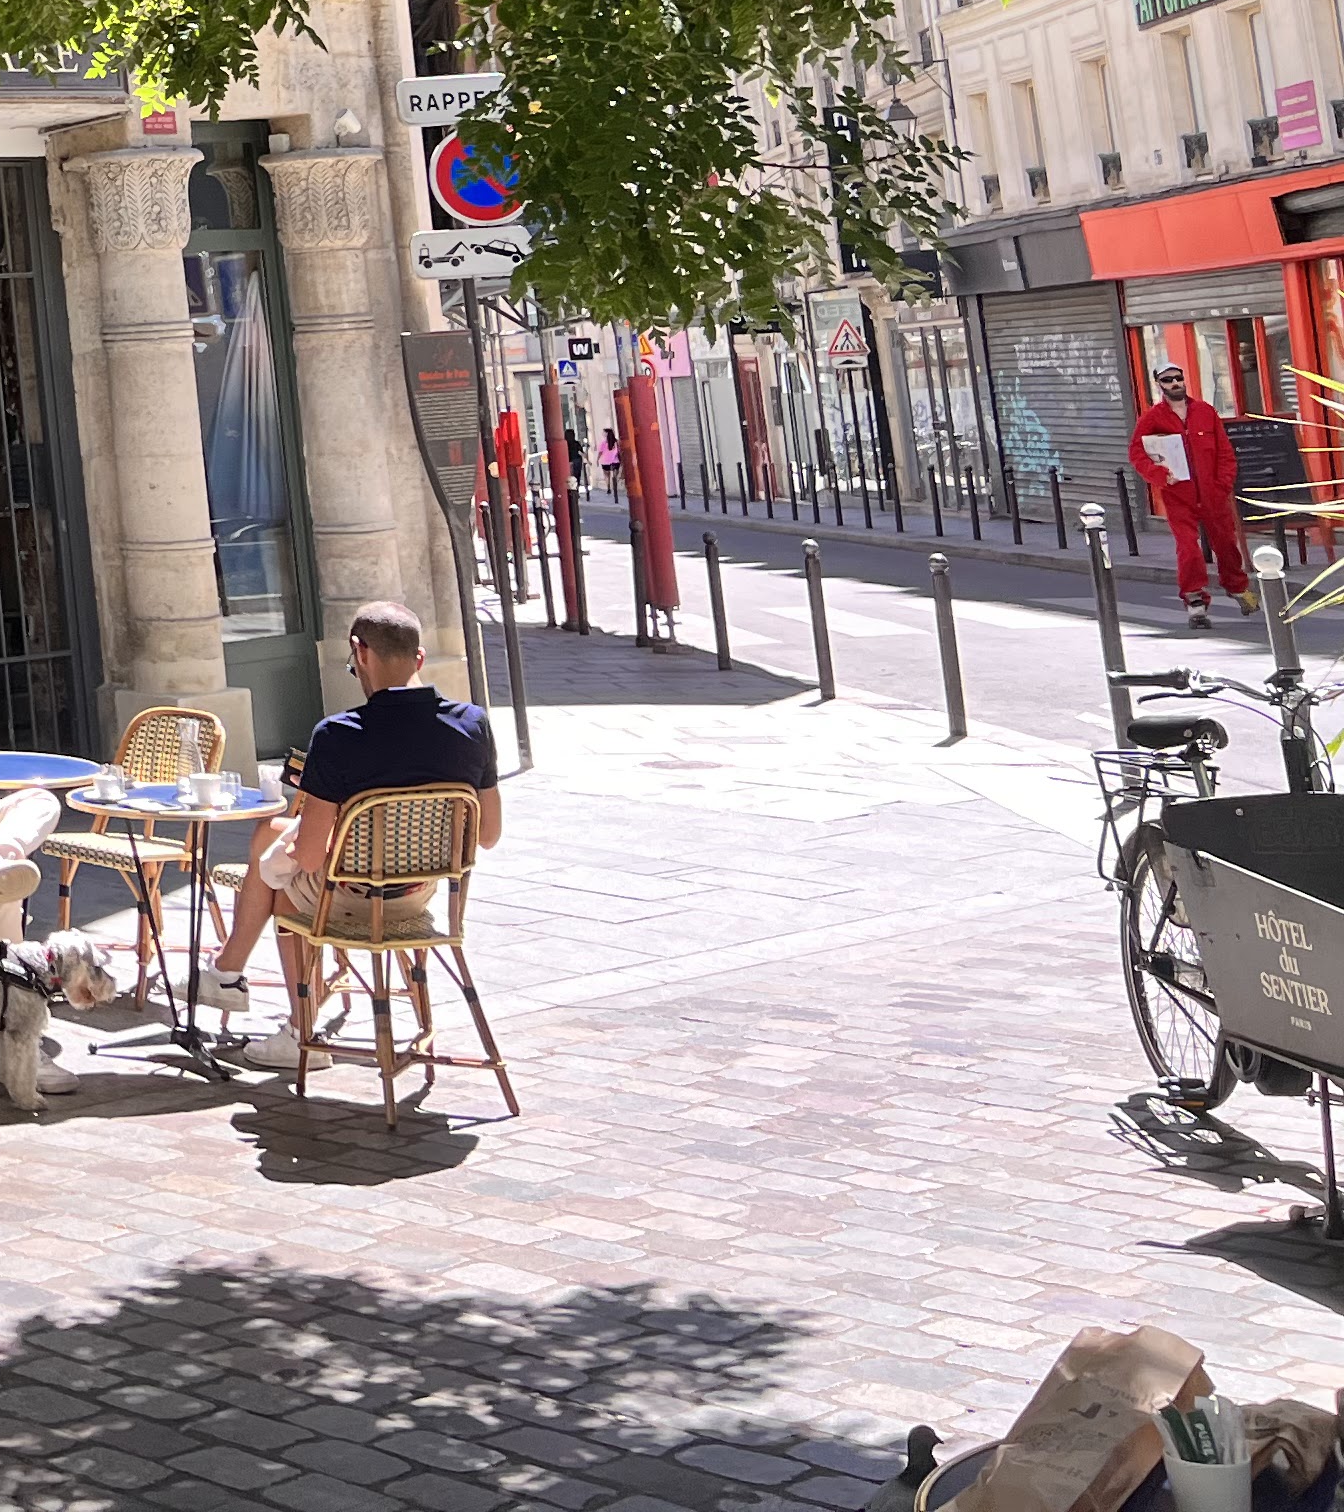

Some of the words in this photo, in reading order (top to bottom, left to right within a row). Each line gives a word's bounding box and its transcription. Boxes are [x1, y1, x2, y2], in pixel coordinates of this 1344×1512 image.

[409, 90, 487, 112] RAPPE
[1254, 910, 1313, 951] HÔTEL
[1279, 947, 1300, 976] du
[1260, 971, 1333, 1016] SENTIER
